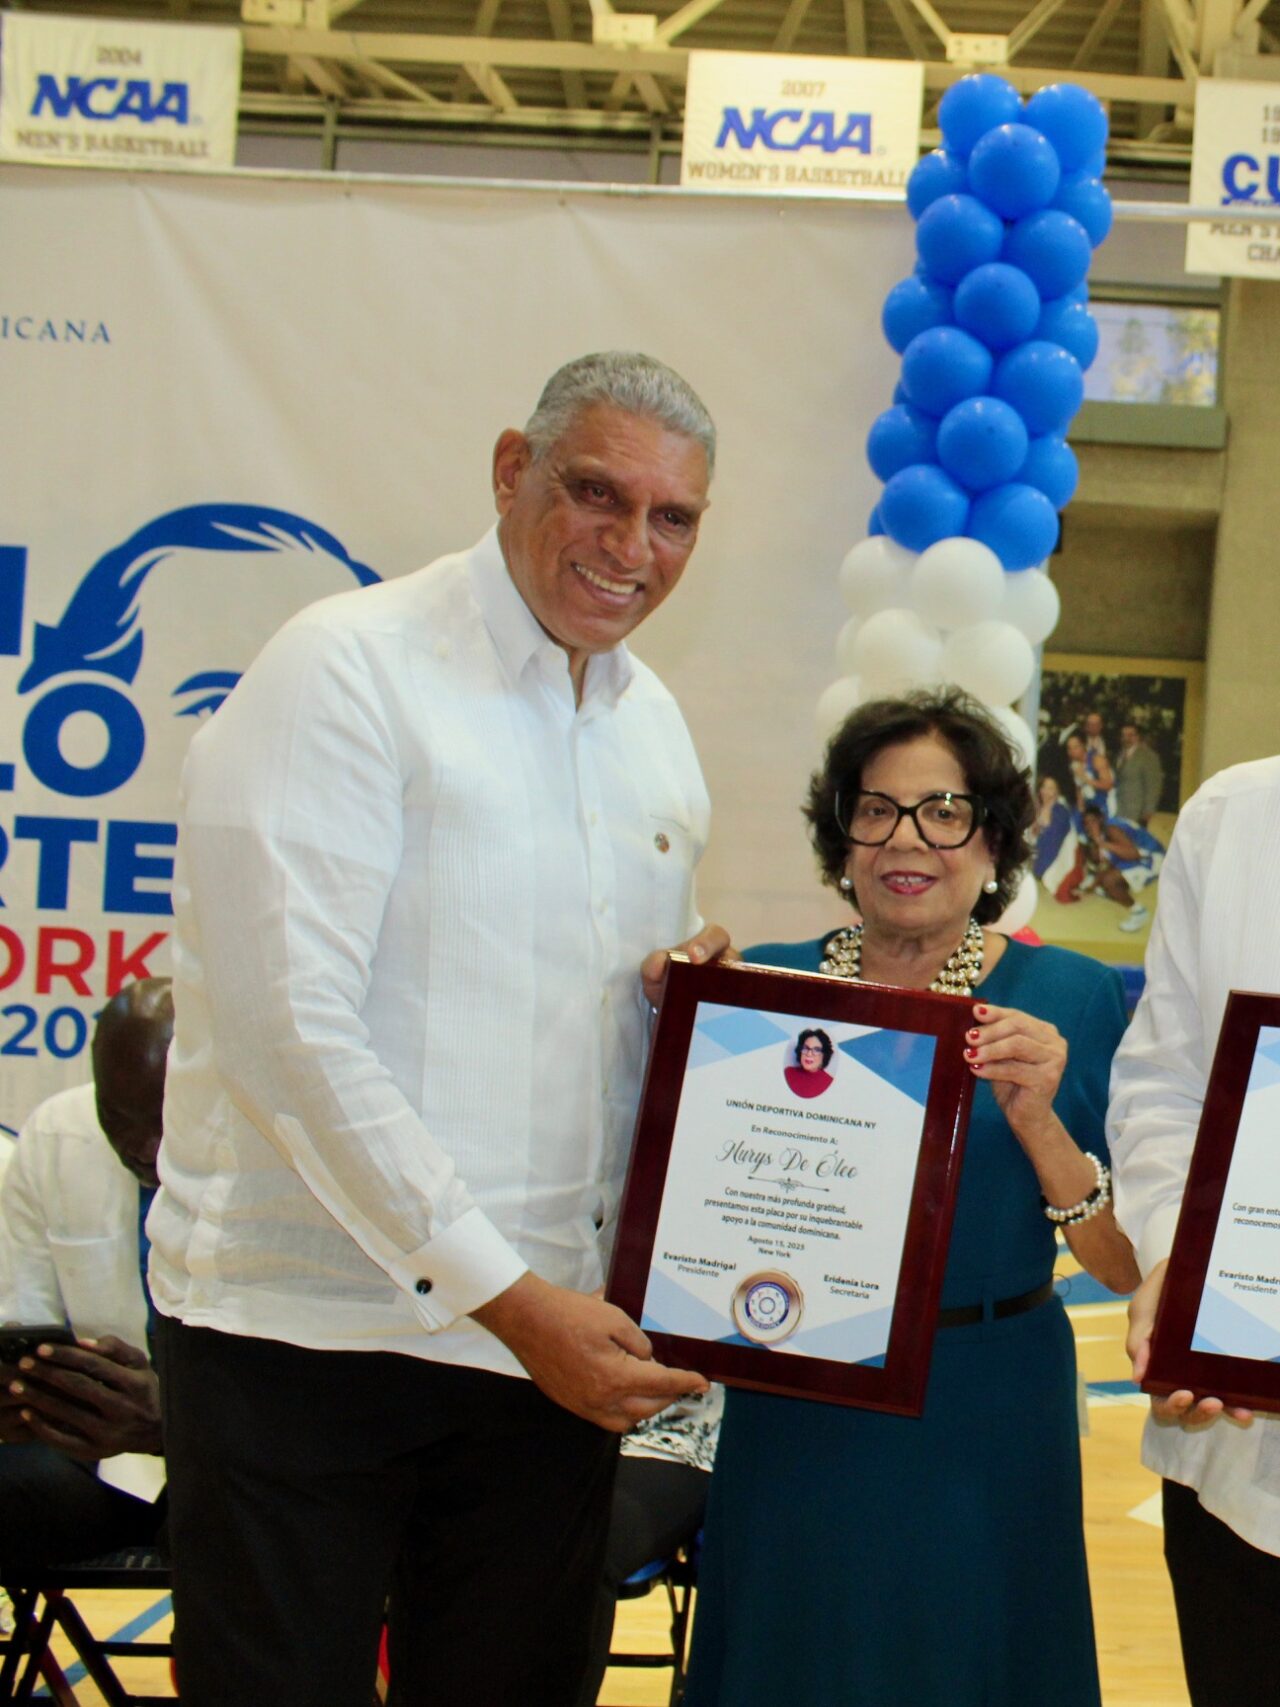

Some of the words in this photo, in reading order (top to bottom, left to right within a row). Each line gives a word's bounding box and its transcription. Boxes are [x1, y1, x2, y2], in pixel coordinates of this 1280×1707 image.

[781, 80, 826, 97] 2007
[30, 73, 188, 125] NCAA
[715, 107, 872, 155] NCAA
[84, 133, 210, 158] BASKETBALL
[688, 161, 780, 182] WOMEN'S
[785, 166, 906, 187] BASKETBALL
[2, 315, 111, 343] ICANA
[726, 1099, 753, 1111] UNIÓN
[756, 1104, 804, 1119] DEPORTIVA
[806, 1112, 862, 1128] DOMINICANA
[864, 1121, 877, 1130] NY
[751, 1125, 761, 1133] En
[763, 1126, 828, 1144] Reconocimiento
[829, 1137, 838, 1145] A:
[779, 1147, 809, 1172] De
[725, 1186, 738, 1197] Con
[740, 1190, 766, 1201] nuestra
[767, 1193, 781, 1204] más
[782, 1196, 815, 1210] profunda
[704, 1198, 749, 1212] presentamos
[750, 1205, 765, 1214] esta
[766, 1207, 785, 1218] placa
[786, 1211, 798, 1220] por
[800, 1213, 808, 1221] su
[808, 1213, 863, 1230] inquebrantable
[1232, 1202, 1247, 1212] Con
[1248, 1205, 1265, 1215] gran
[721, 1214, 743, 1226] apoyo
[750, 1217, 757, 1226] la
[758, 1220, 796, 1233] comunidad
[798, 1226, 840, 1240] dominicana.
[1233, 1217, 1280, 1229] reconocemos
[747, 1235, 773, 1247] Agosto
[663, 1252, 697, 1264] Evaristo
[699, 1257, 737, 1271] Madrigal
[758, 1247, 773, 1256] New
[775, 1249, 791, 1259] York
[677, 1264, 720, 1278] Presidente
[1219, 1269, 1254, 1282] Evaristo
[824, 1274, 859, 1287] Eridenia
[860, 1280, 880, 1291] Lora
[1233, 1282, 1278, 1295] Presidente
[830, 1286, 870, 1300] Secretaria
